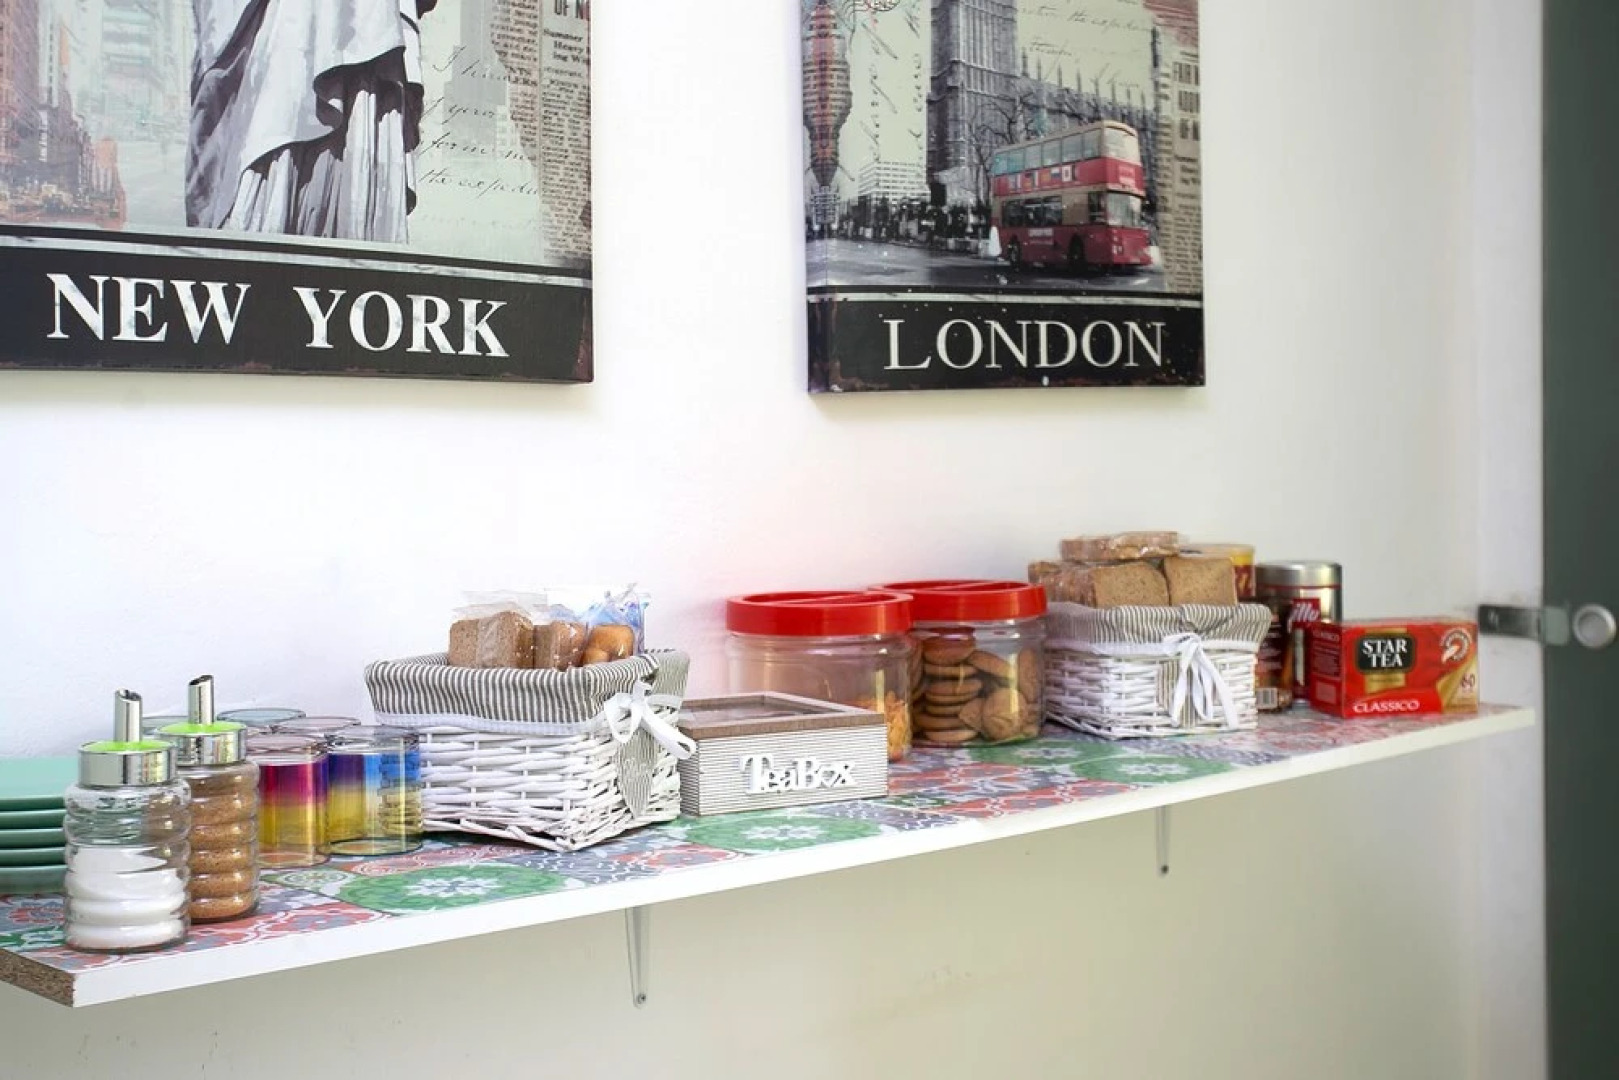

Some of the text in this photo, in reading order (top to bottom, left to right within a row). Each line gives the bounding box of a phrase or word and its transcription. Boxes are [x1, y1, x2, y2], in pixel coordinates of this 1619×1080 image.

[46, 273, 510, 357] NEW YORK
[883, 318, 1166, 370] LONDON
[1362, 638, 1408, 655] STAR
[1368, 653, 1403, 668] TEA
[1353, 699, 1420, 713] CLASSICO
